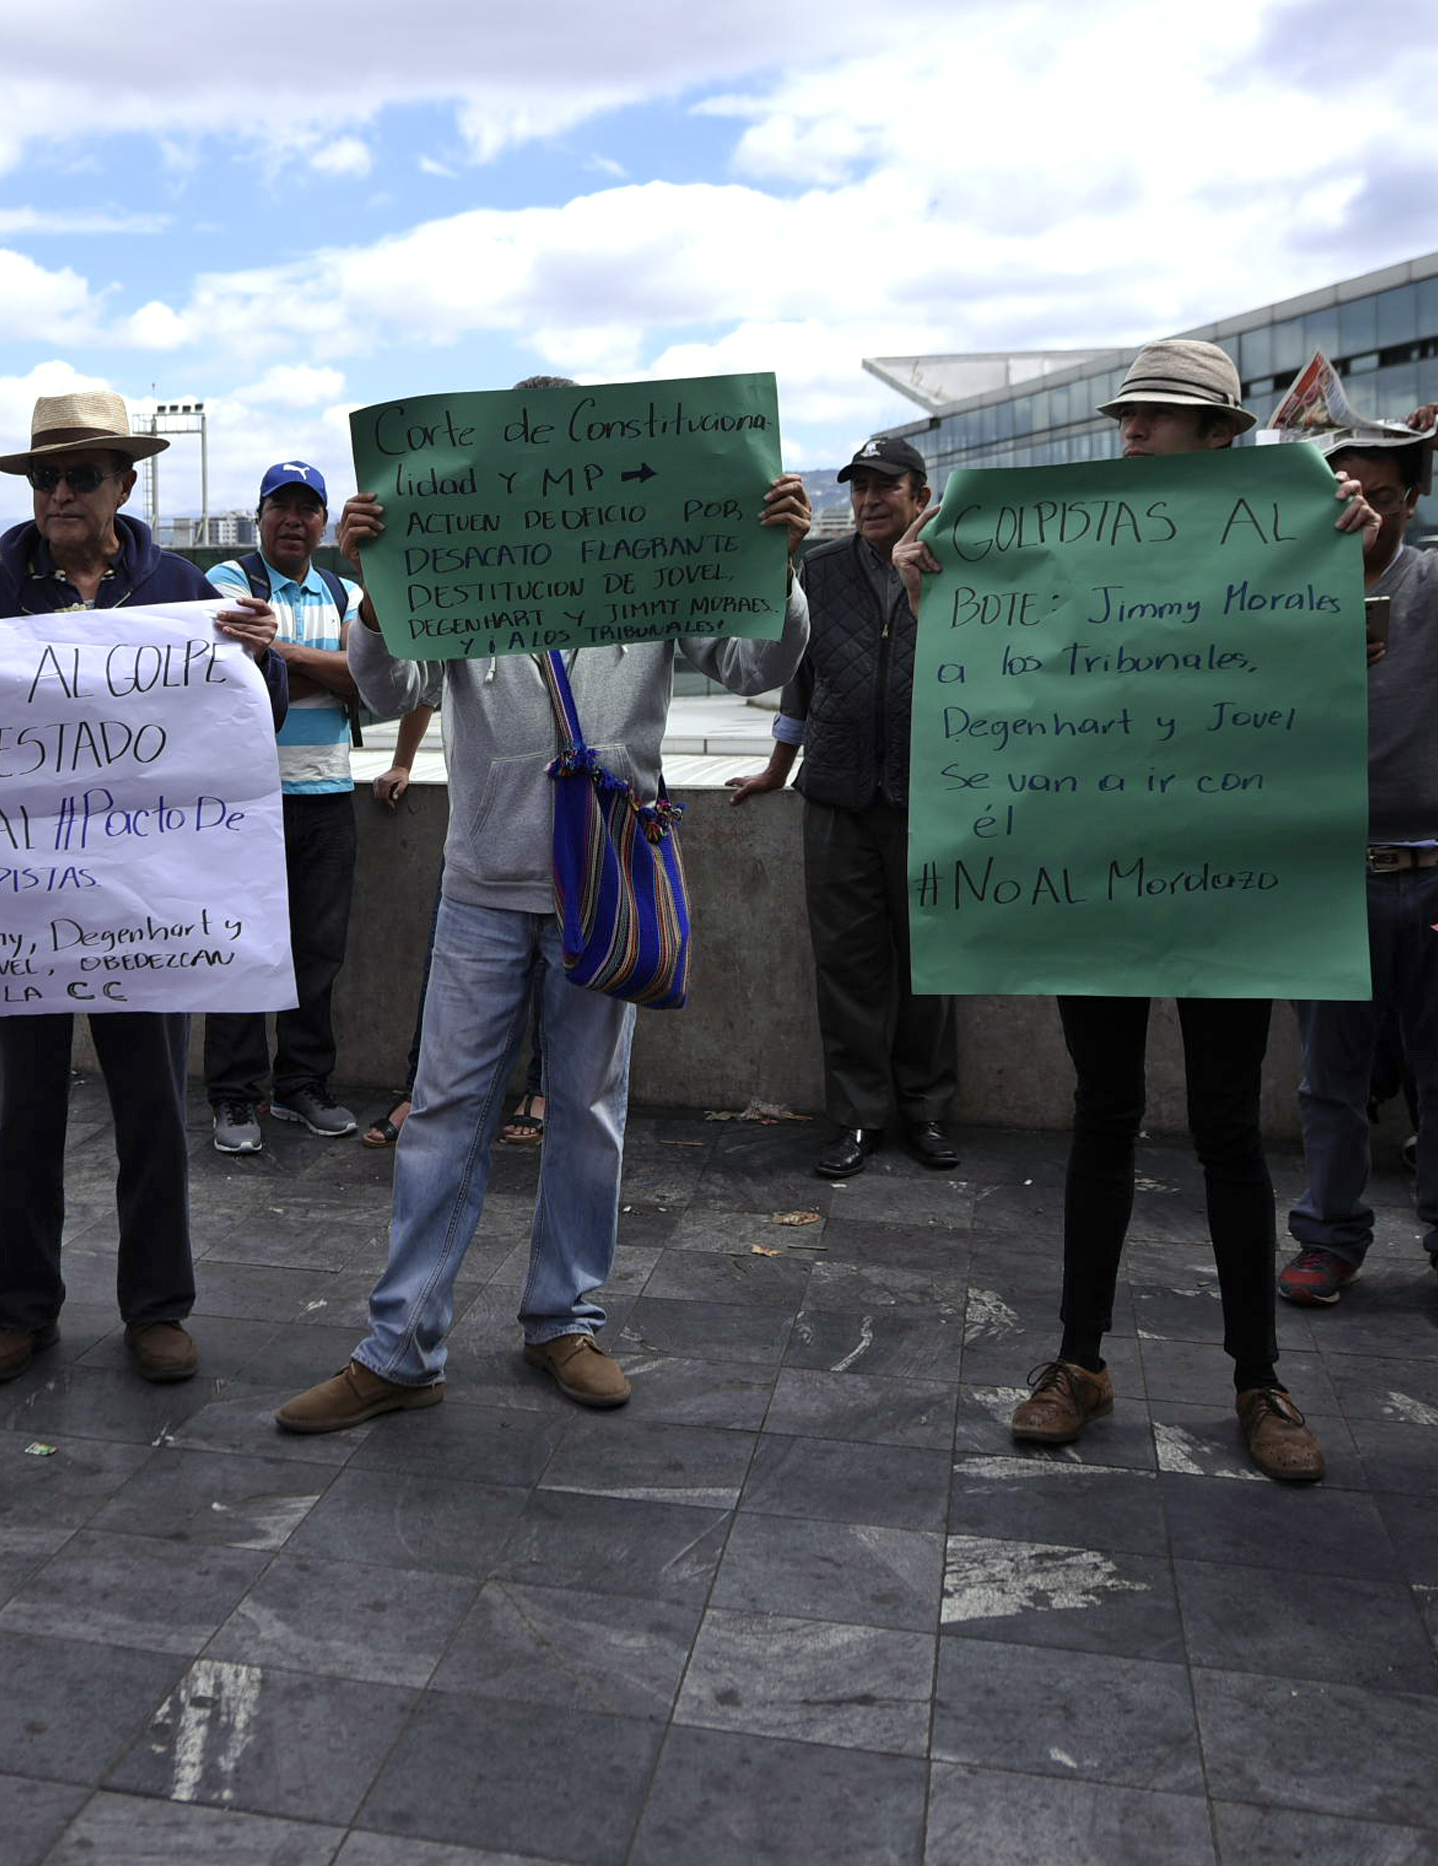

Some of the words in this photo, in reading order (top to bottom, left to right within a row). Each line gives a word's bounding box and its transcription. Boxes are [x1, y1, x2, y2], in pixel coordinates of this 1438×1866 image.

[375, 405, 476, 455] Corte
[503, 407, 555, 445] de
[395, 462, 477, 497] lidad
[407, 511, 501, 537] ACTUEN
[525, 509, 557, 531] DE
[562, 504, 646, 531] OFICIO
[952, 500, 1178, 562] GOLPISTAS
[1220, 498, 1298, 546] AL
[404, 542, 553, 577] DESACATO
[580, 533, 742, 564] FLAGRANTE
[407, 577, 585, 613] DESTITUCION
[603, 572, 635, 595] DE
[1087, 585, 1202, 624] Jimmy
[1223, 580, 1342, 615] Morales
[407, 609, 545, 640] DEGENHART
[27, 644, 94, 704] AL
[105, 638, 227, 698] GOLPE
[937, 663, 966, 684] a
[1001, 645, 1043, 676] los
[941, 705, 1135, 752] Degenhart
[1156, 714, 1176, 742] y
[1207, 701, 1296, 732] Jovel
[1007, 773, 1078, 793] van
[1098, 773, 1125, 793] a
[1148, 767, 1176, 794] ir
[1197, 772, 1264, 794] con
[972, 803, 1014, 839] él
[50, 908, 211, 952] Degenhart
[224, 920, 242, 940] y
[80, 949, 236, 972] OBEDEZCAN
[4, 986, 43, 1002] LA
